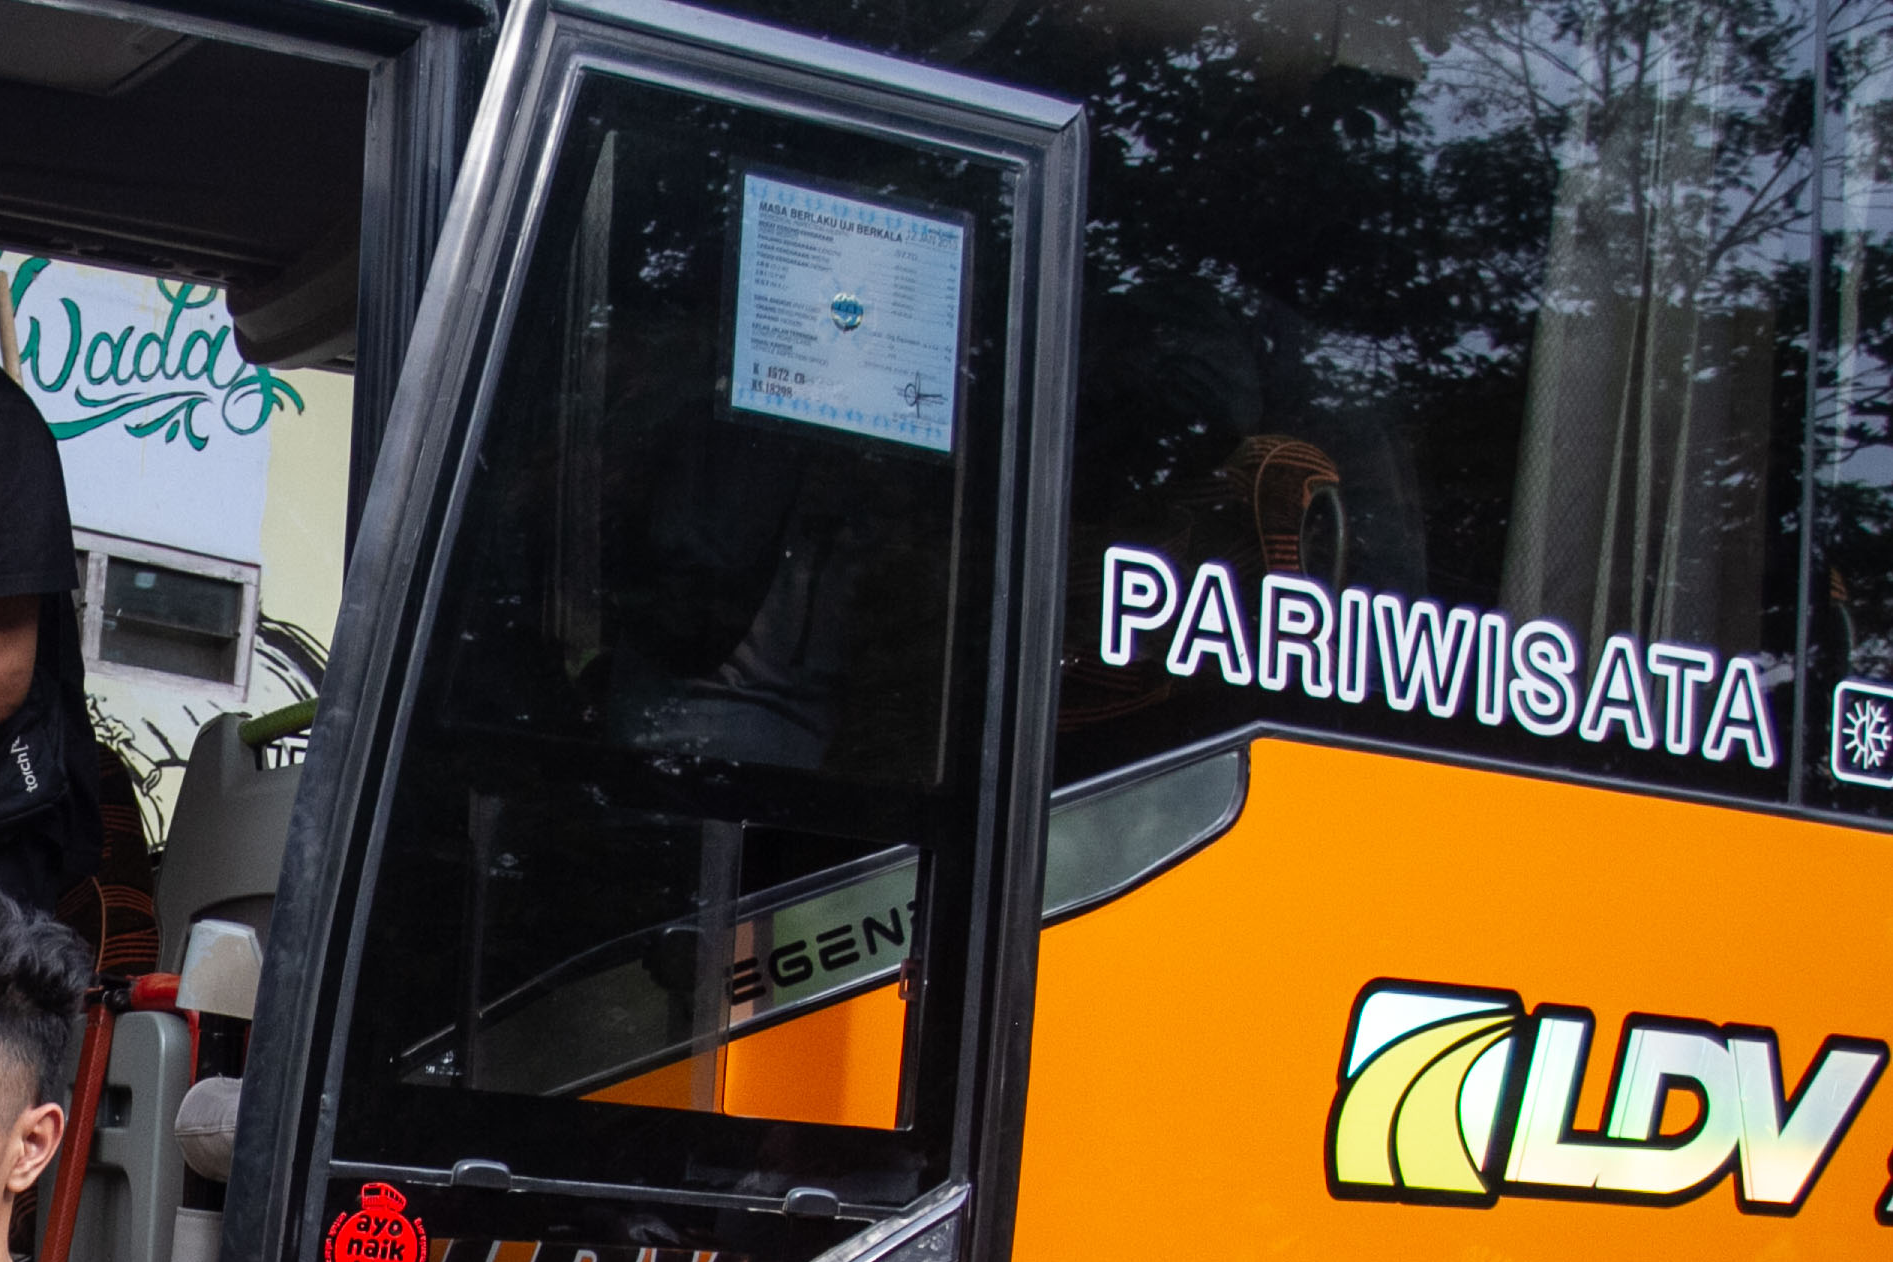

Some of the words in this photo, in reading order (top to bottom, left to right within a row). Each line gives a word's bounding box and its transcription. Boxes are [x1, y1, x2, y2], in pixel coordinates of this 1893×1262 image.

[759, 202, 787, 217] MASA
[790, 207, 838, 229] BERLAKU
[840, 220, 855, 232] UJI
[856, 223, 903, 243] BERKALA
[1100, 546, 1776, 769] PARIWISATA
[726, 898, 916, 1006] EGEN
[1499, 1003, 1891, 1218] LDV
[347, 1237, 405, 1261] naik
[356, 1214, 403, 1236] ayo
